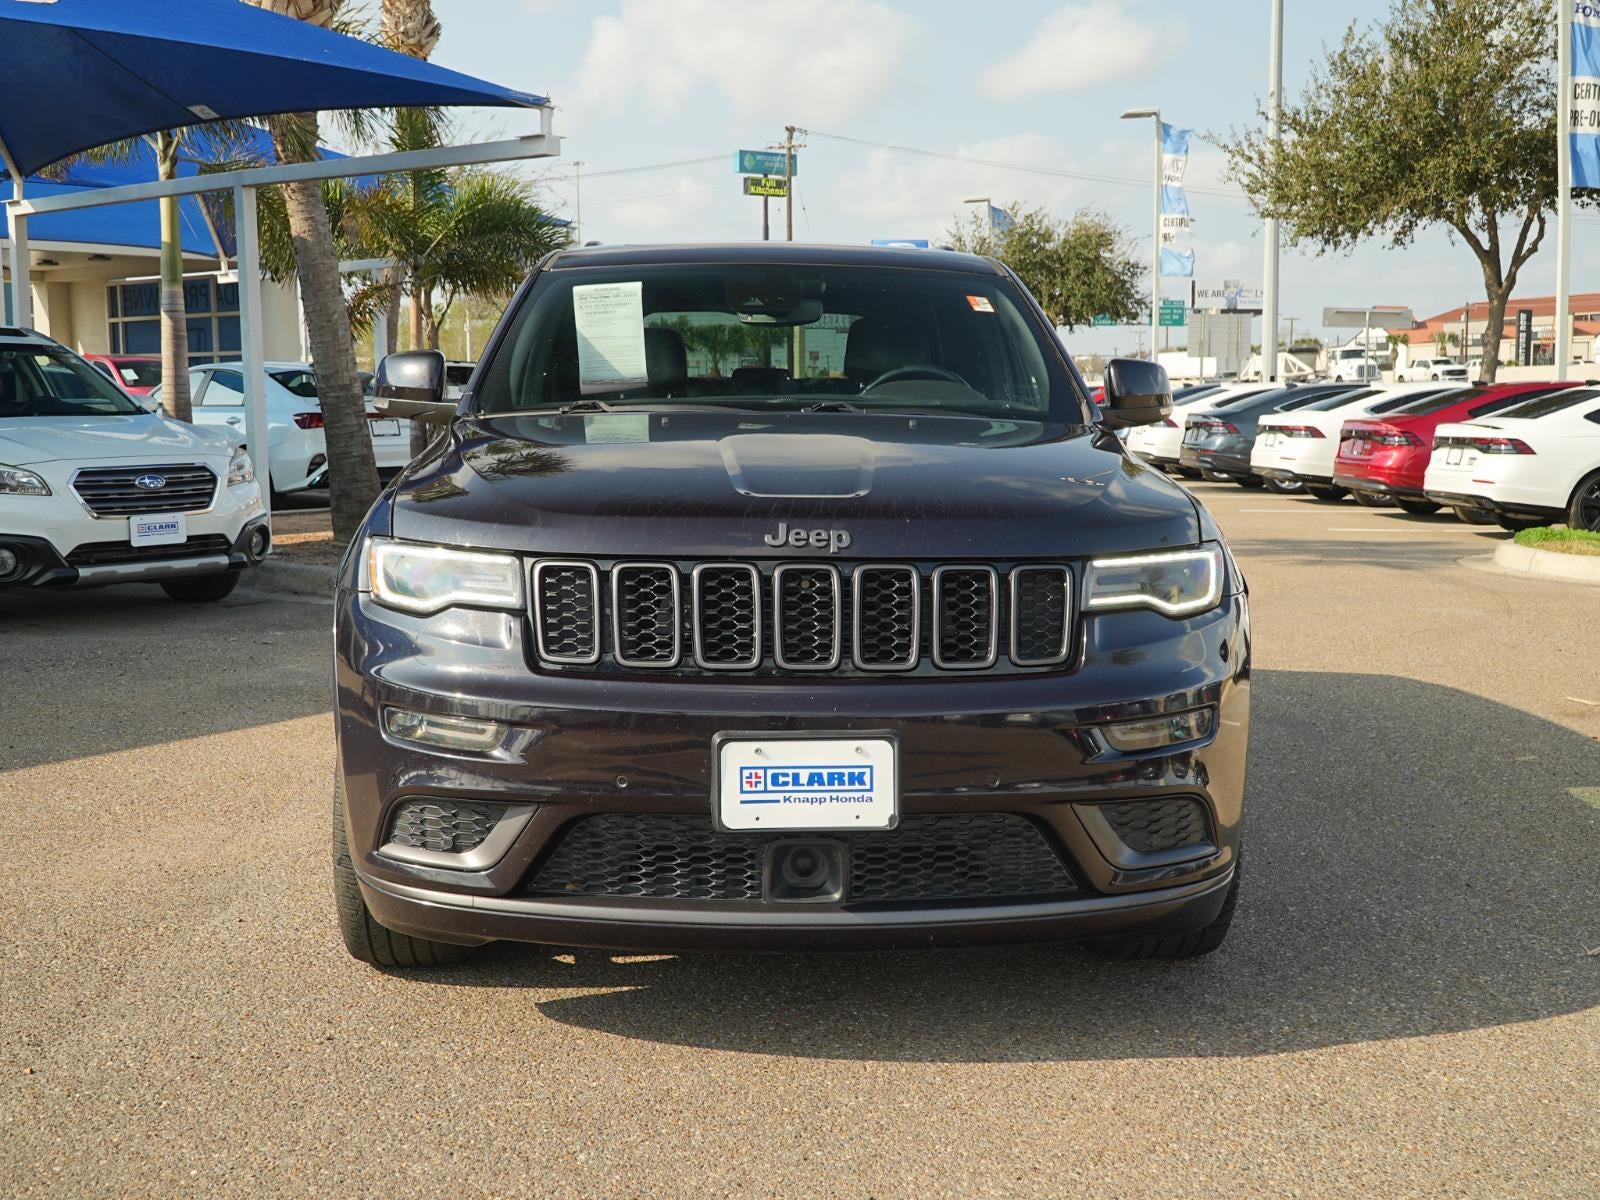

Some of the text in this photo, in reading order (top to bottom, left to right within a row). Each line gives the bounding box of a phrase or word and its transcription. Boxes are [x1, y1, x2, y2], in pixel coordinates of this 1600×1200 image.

[761, 178, 776, 187] Full
[1197, 289, 1209, 298] WE
[764, 522, 851, 553] Jeep
[771, 772, 867, 787] CLARK
[783, 794, 873, 806] Knapp Honda
